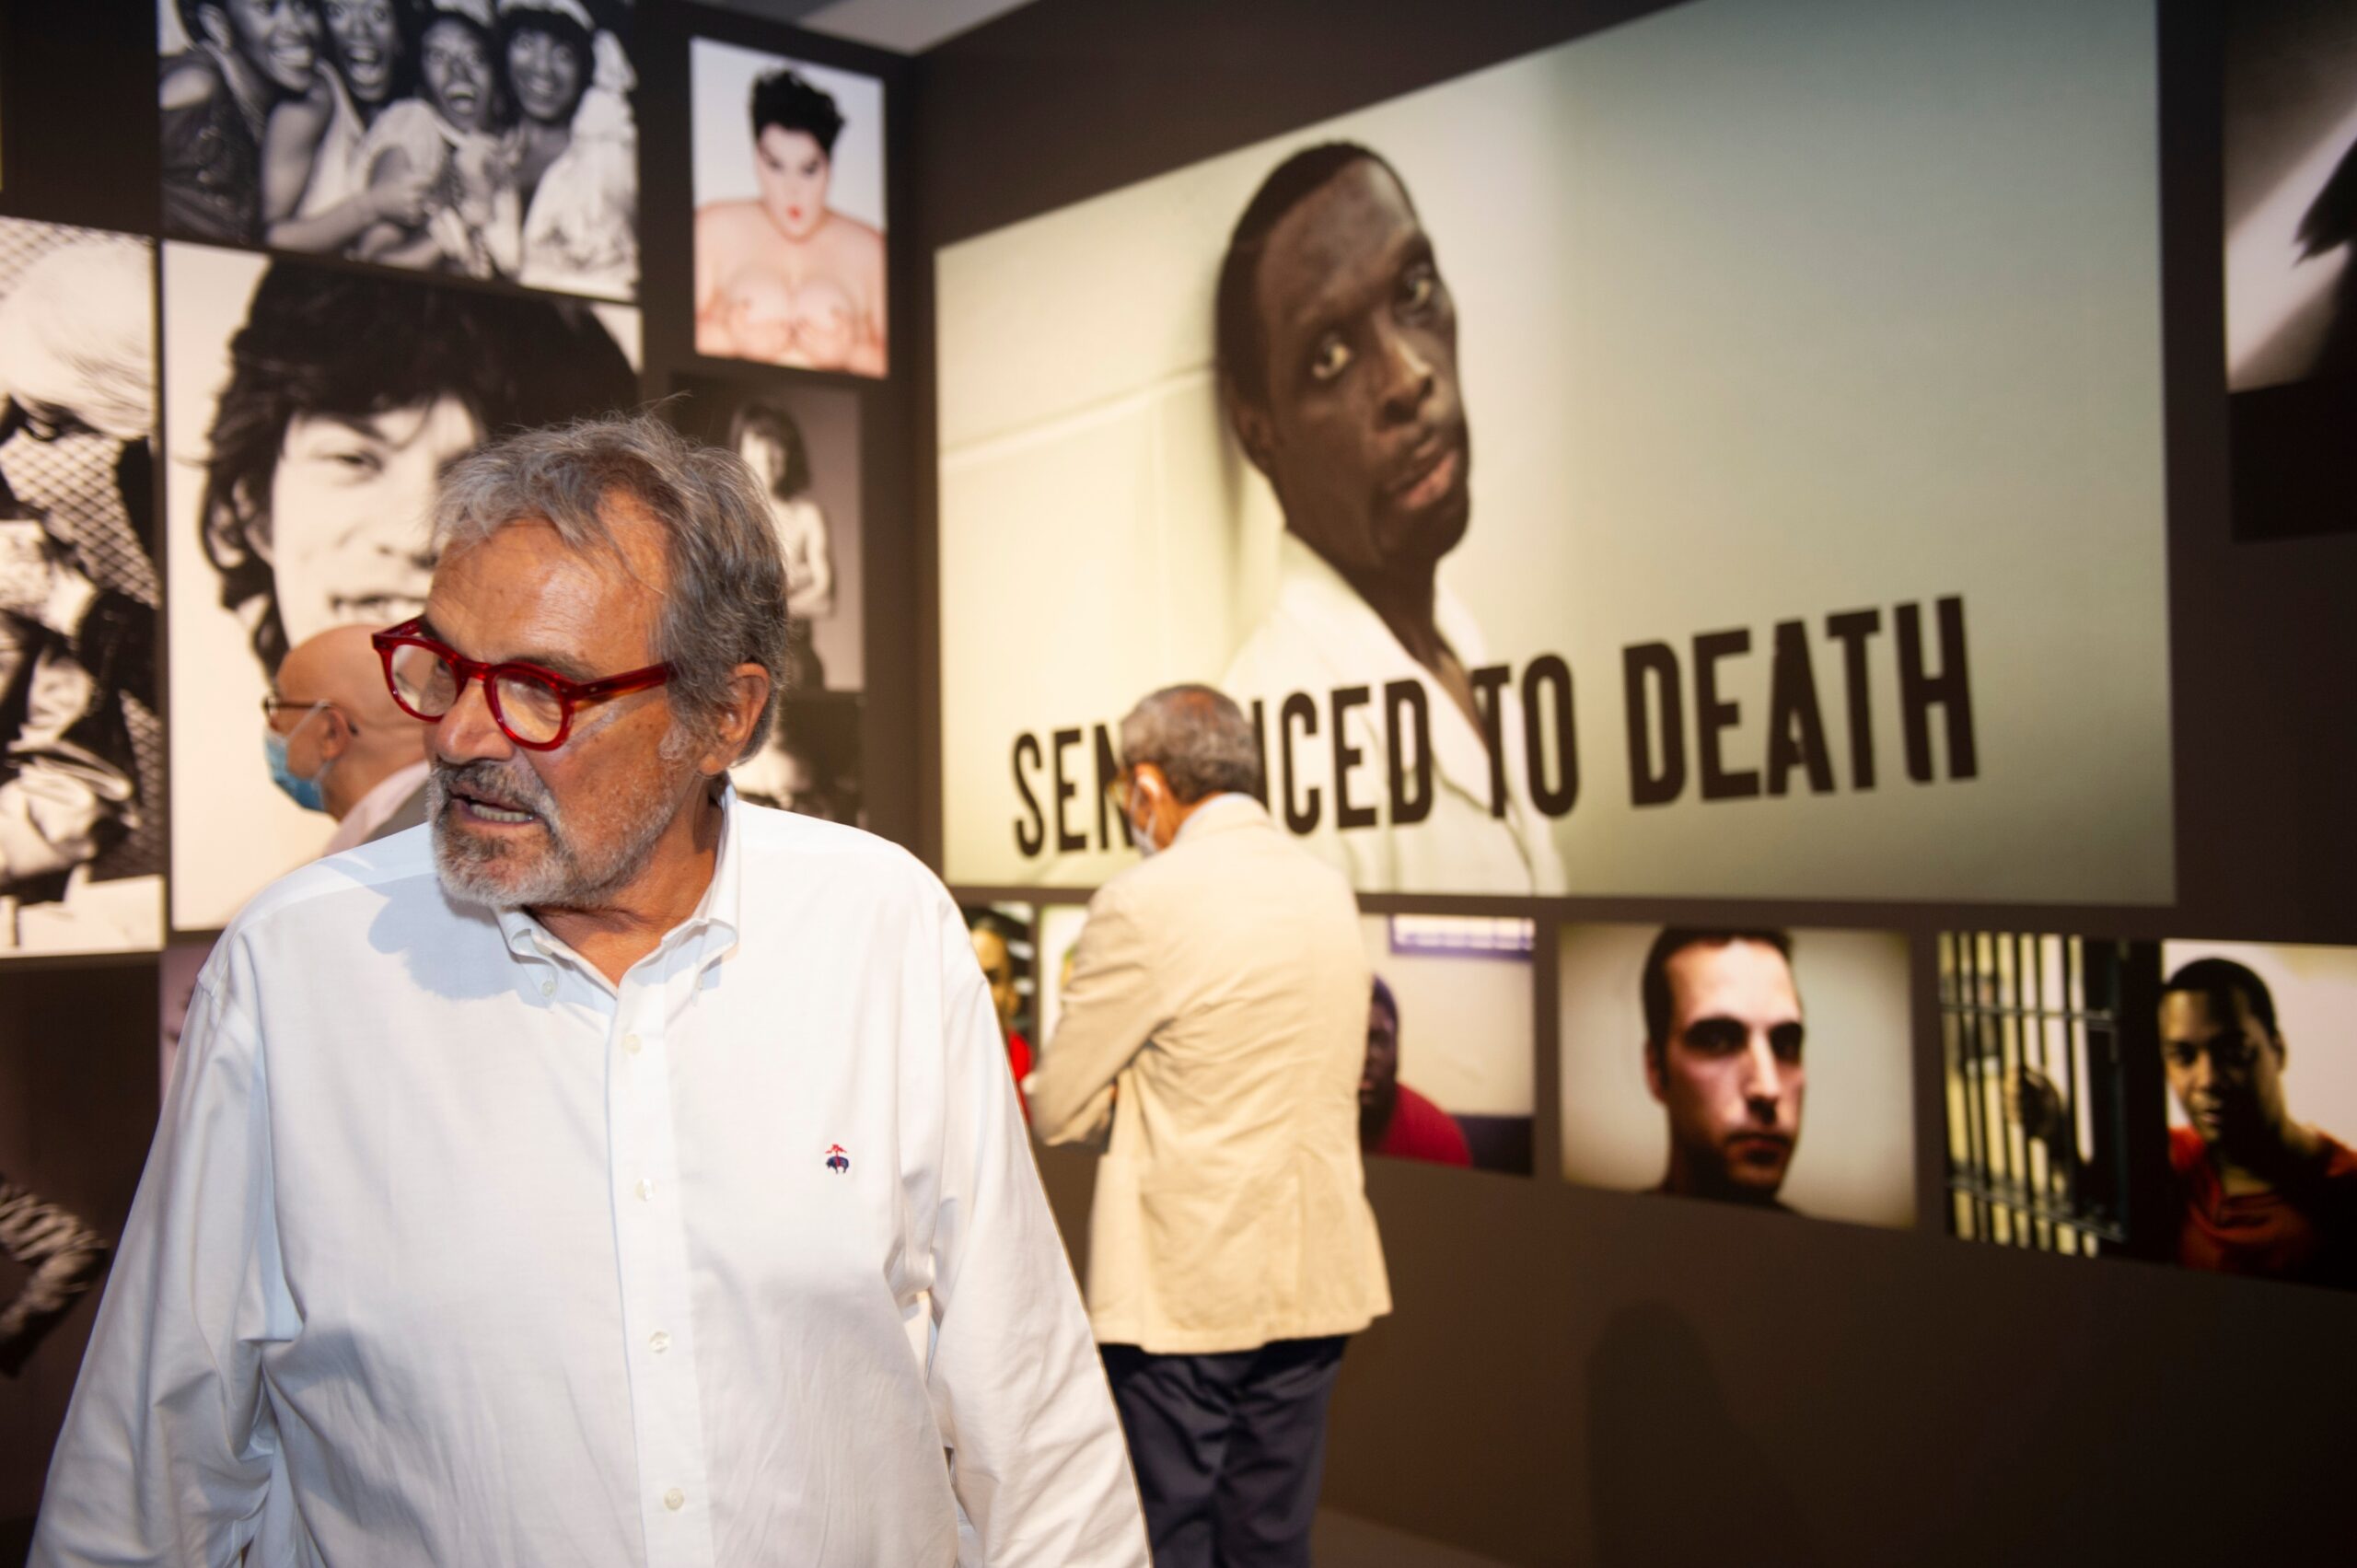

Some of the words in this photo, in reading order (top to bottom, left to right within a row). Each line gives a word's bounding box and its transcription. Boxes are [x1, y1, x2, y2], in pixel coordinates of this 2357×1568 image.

[1013, 677, 1434, 859] SENCED
[1470, 652, 1580, 819] TO
[1622, 594, 1979, 809] DEATH
